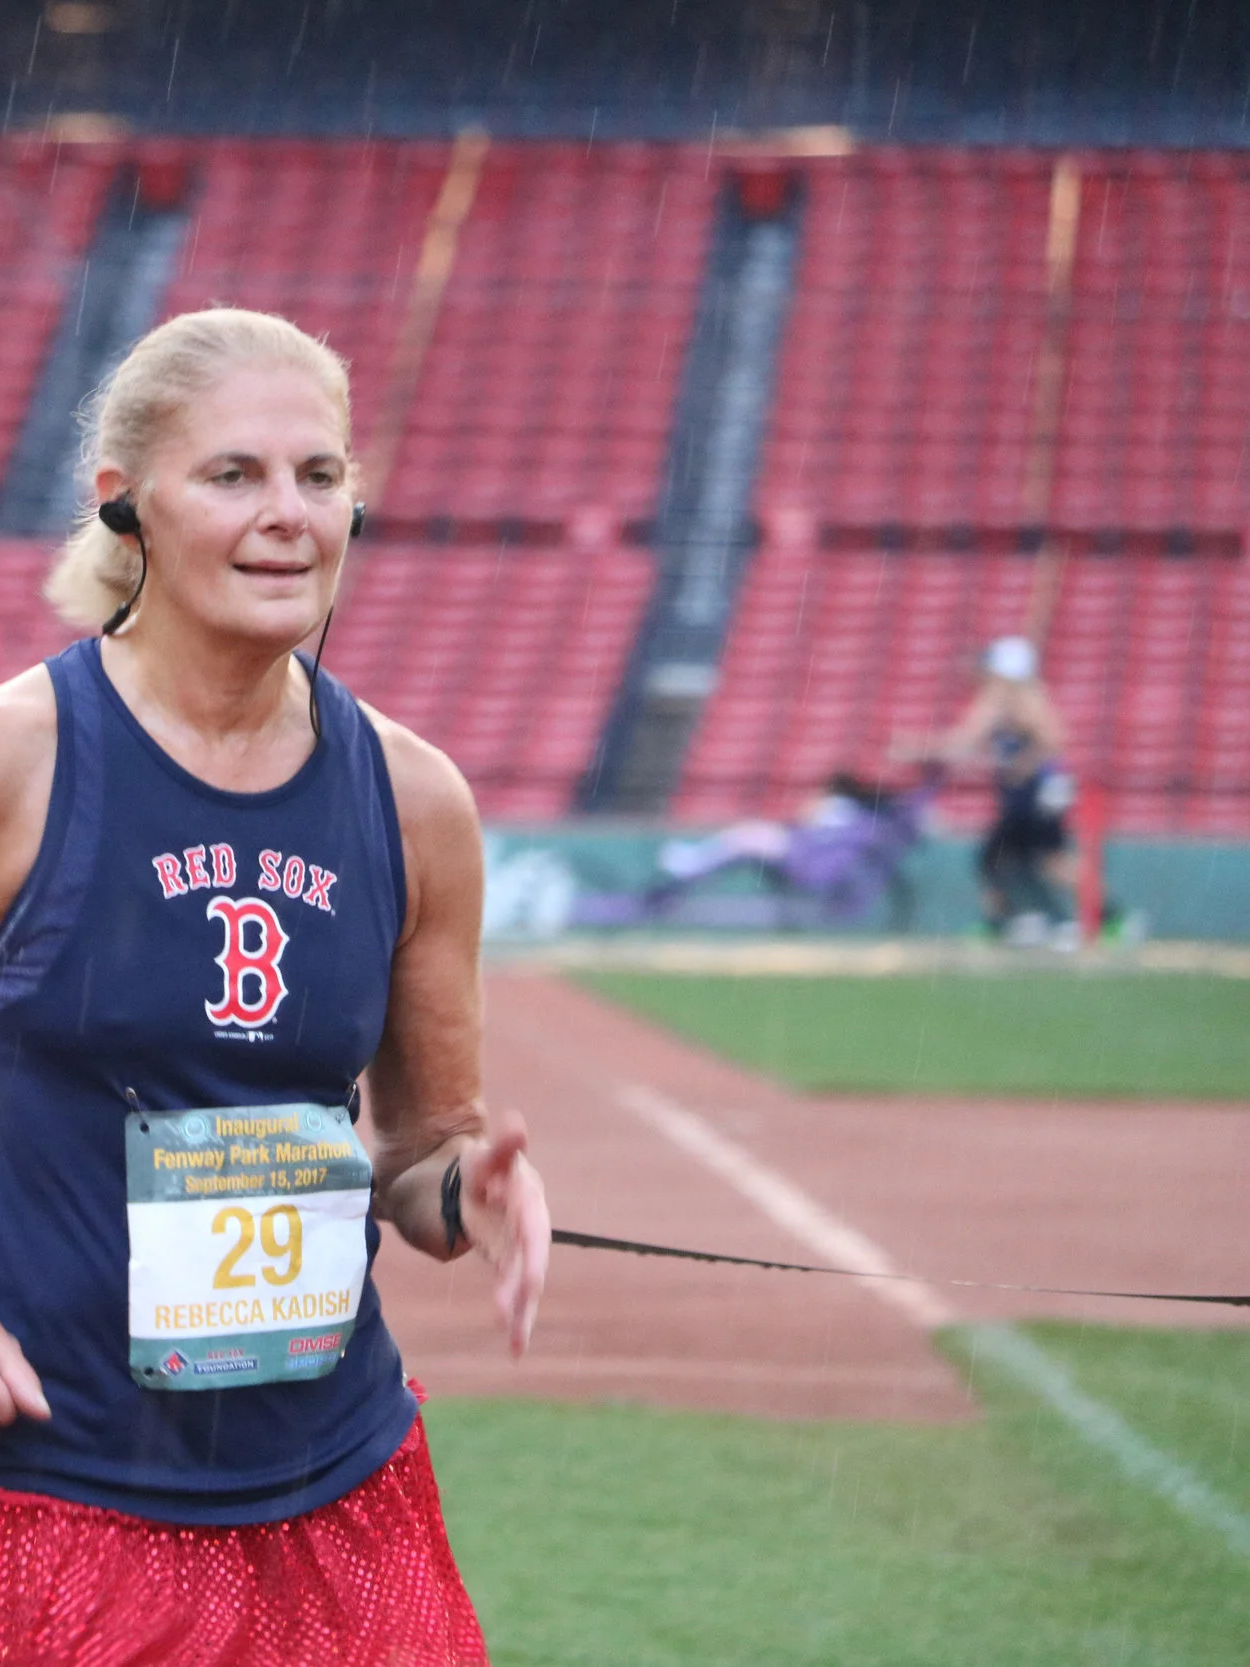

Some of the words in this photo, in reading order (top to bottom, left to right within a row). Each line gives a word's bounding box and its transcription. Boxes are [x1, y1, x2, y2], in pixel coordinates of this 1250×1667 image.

[152, 843, 237, 899] RED
[258, 849, 337, 911] SOX
[205, 895, 290, 1028] B
[216, 1112, 298, 1138] Inaugural
[153, 1148, 225, 1169] Fenway
[230, 1143, 270, 1165] Park
[276, 1140, 352, 1162] Marathon
[185, 1172, 265, 1193] September
[270, 1170, 292, 1190] 15,
[295, 1167, 327, 1186] 2017
[212, 1204, 303, 1290] 29
[154, 1299, 265, 1330] REBECCA
[272, 1289, 350, 1321] KADISH
